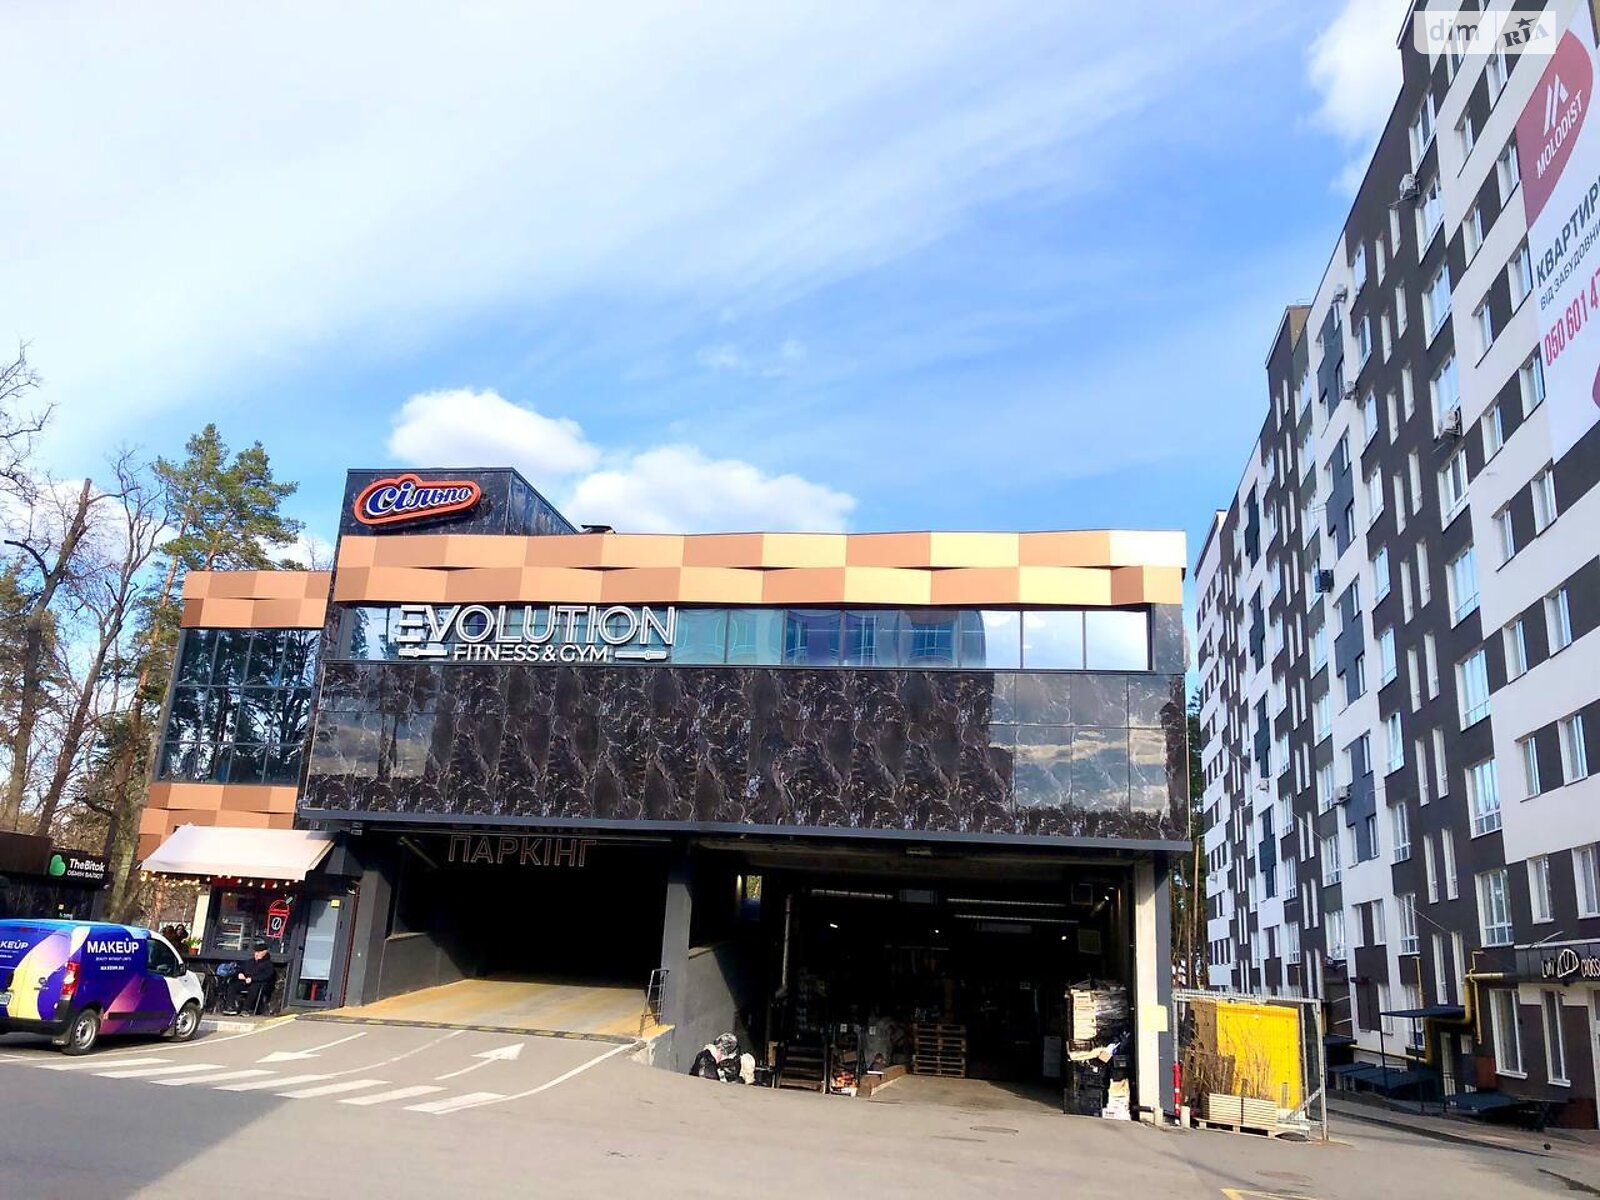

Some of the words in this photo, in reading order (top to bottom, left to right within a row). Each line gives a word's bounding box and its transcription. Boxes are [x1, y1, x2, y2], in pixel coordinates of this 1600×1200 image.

[1536, 89, 1582, 179] MOLODIST
[1536, 175, 1600, 288] КВАРТИР
[1540, 286, 1554, 311] ВІД
[1544, 318, 1566, 367] 050
[1565, 289, 1588, 341] 601
[366, 481, 472, 516] Сільпо
[397, 604, 676, 645] EVOLUTION
[453, 643, 540, 662] FITNESS
[542, 644, 556, 662] &
[559, 644, 609, 663] GYM
[69, 858, 106, 873] TheBitok
[448, 834, 598, 868] ПАРКІНГ
[0, 939, 29, 950] KEUP
